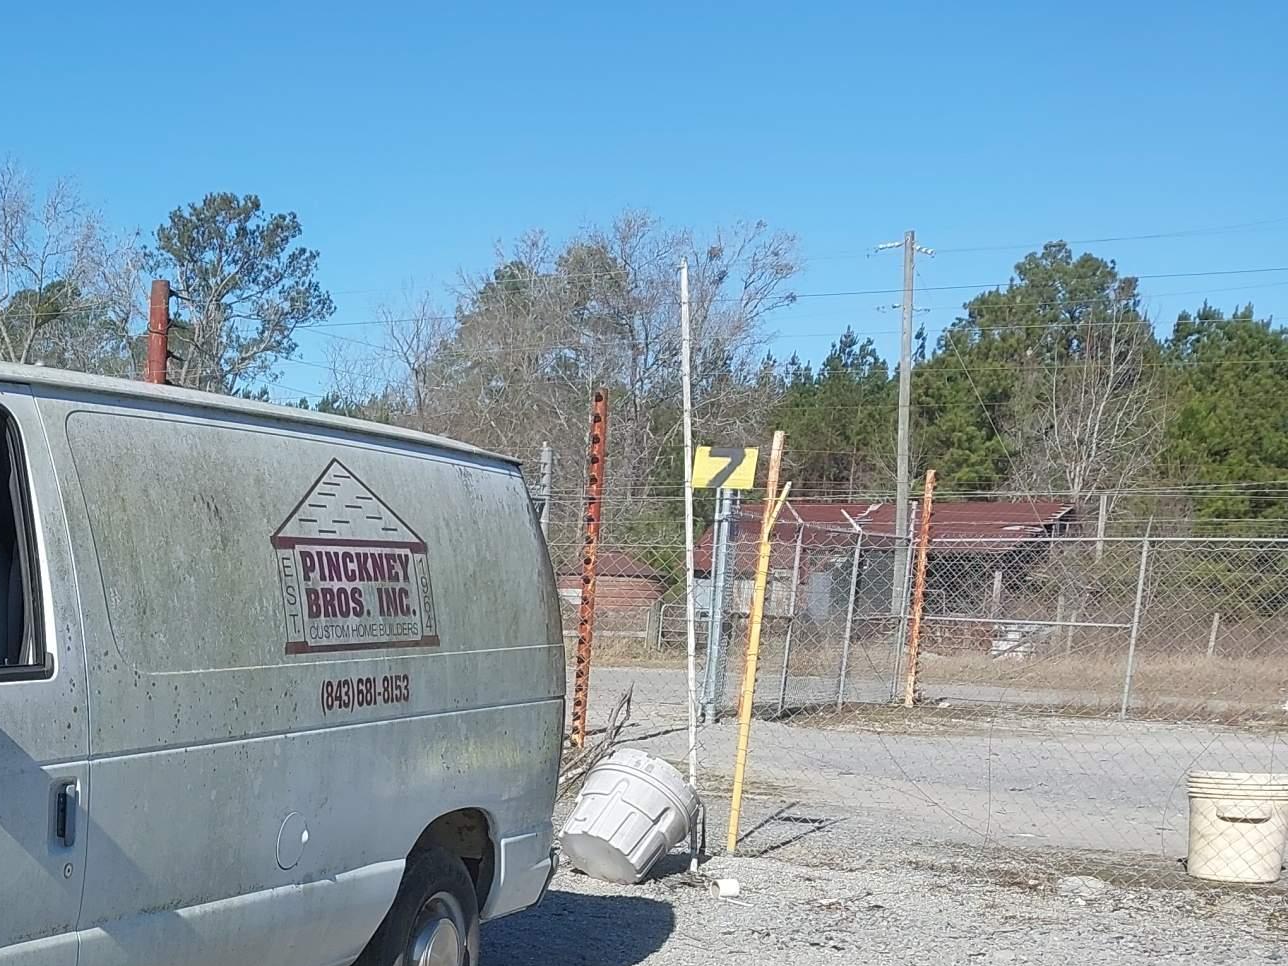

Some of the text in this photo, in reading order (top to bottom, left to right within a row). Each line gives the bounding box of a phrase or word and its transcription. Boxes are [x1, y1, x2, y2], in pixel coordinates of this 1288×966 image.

[706, 447, 745, 488] 7
[299, 550, 410, 583] PINCKNEY
[305, 587, 417, 619] BROS. INC.
[418, 558, 434, 633] 1964
[309, 621, 419, 640] CUSTOM HOME BUILDERS
